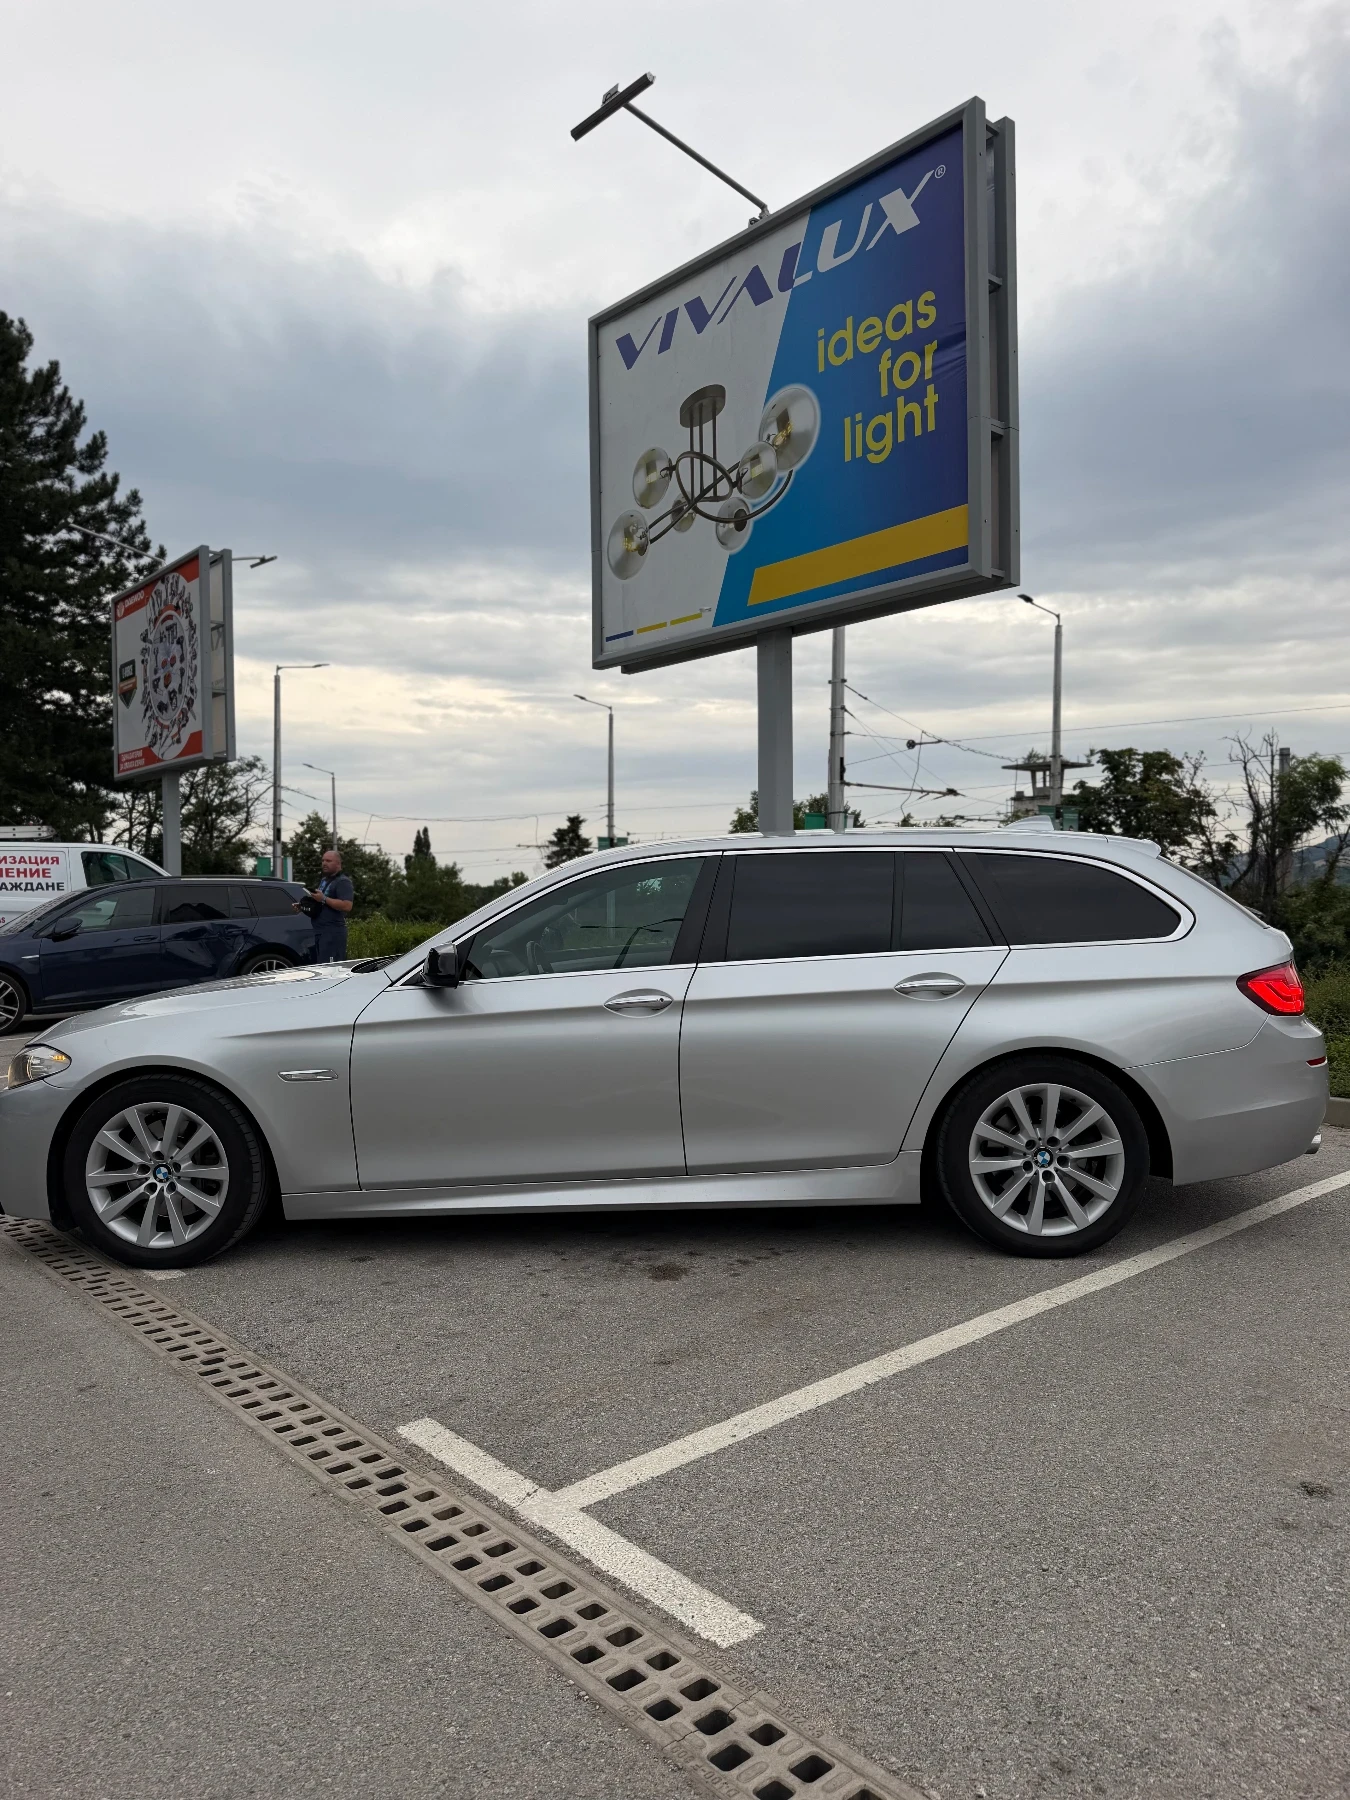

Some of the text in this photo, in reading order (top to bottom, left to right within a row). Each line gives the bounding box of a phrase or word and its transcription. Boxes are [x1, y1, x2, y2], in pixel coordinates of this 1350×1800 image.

[817, 291, 936, 373] ideas
[879, 340, 937, 397] for
[844, 384, 938, 464] light
[0, 856, 59, 866] ИЗАЦИЯ
[0, 882, 65, 892] АЖДАНЕ
